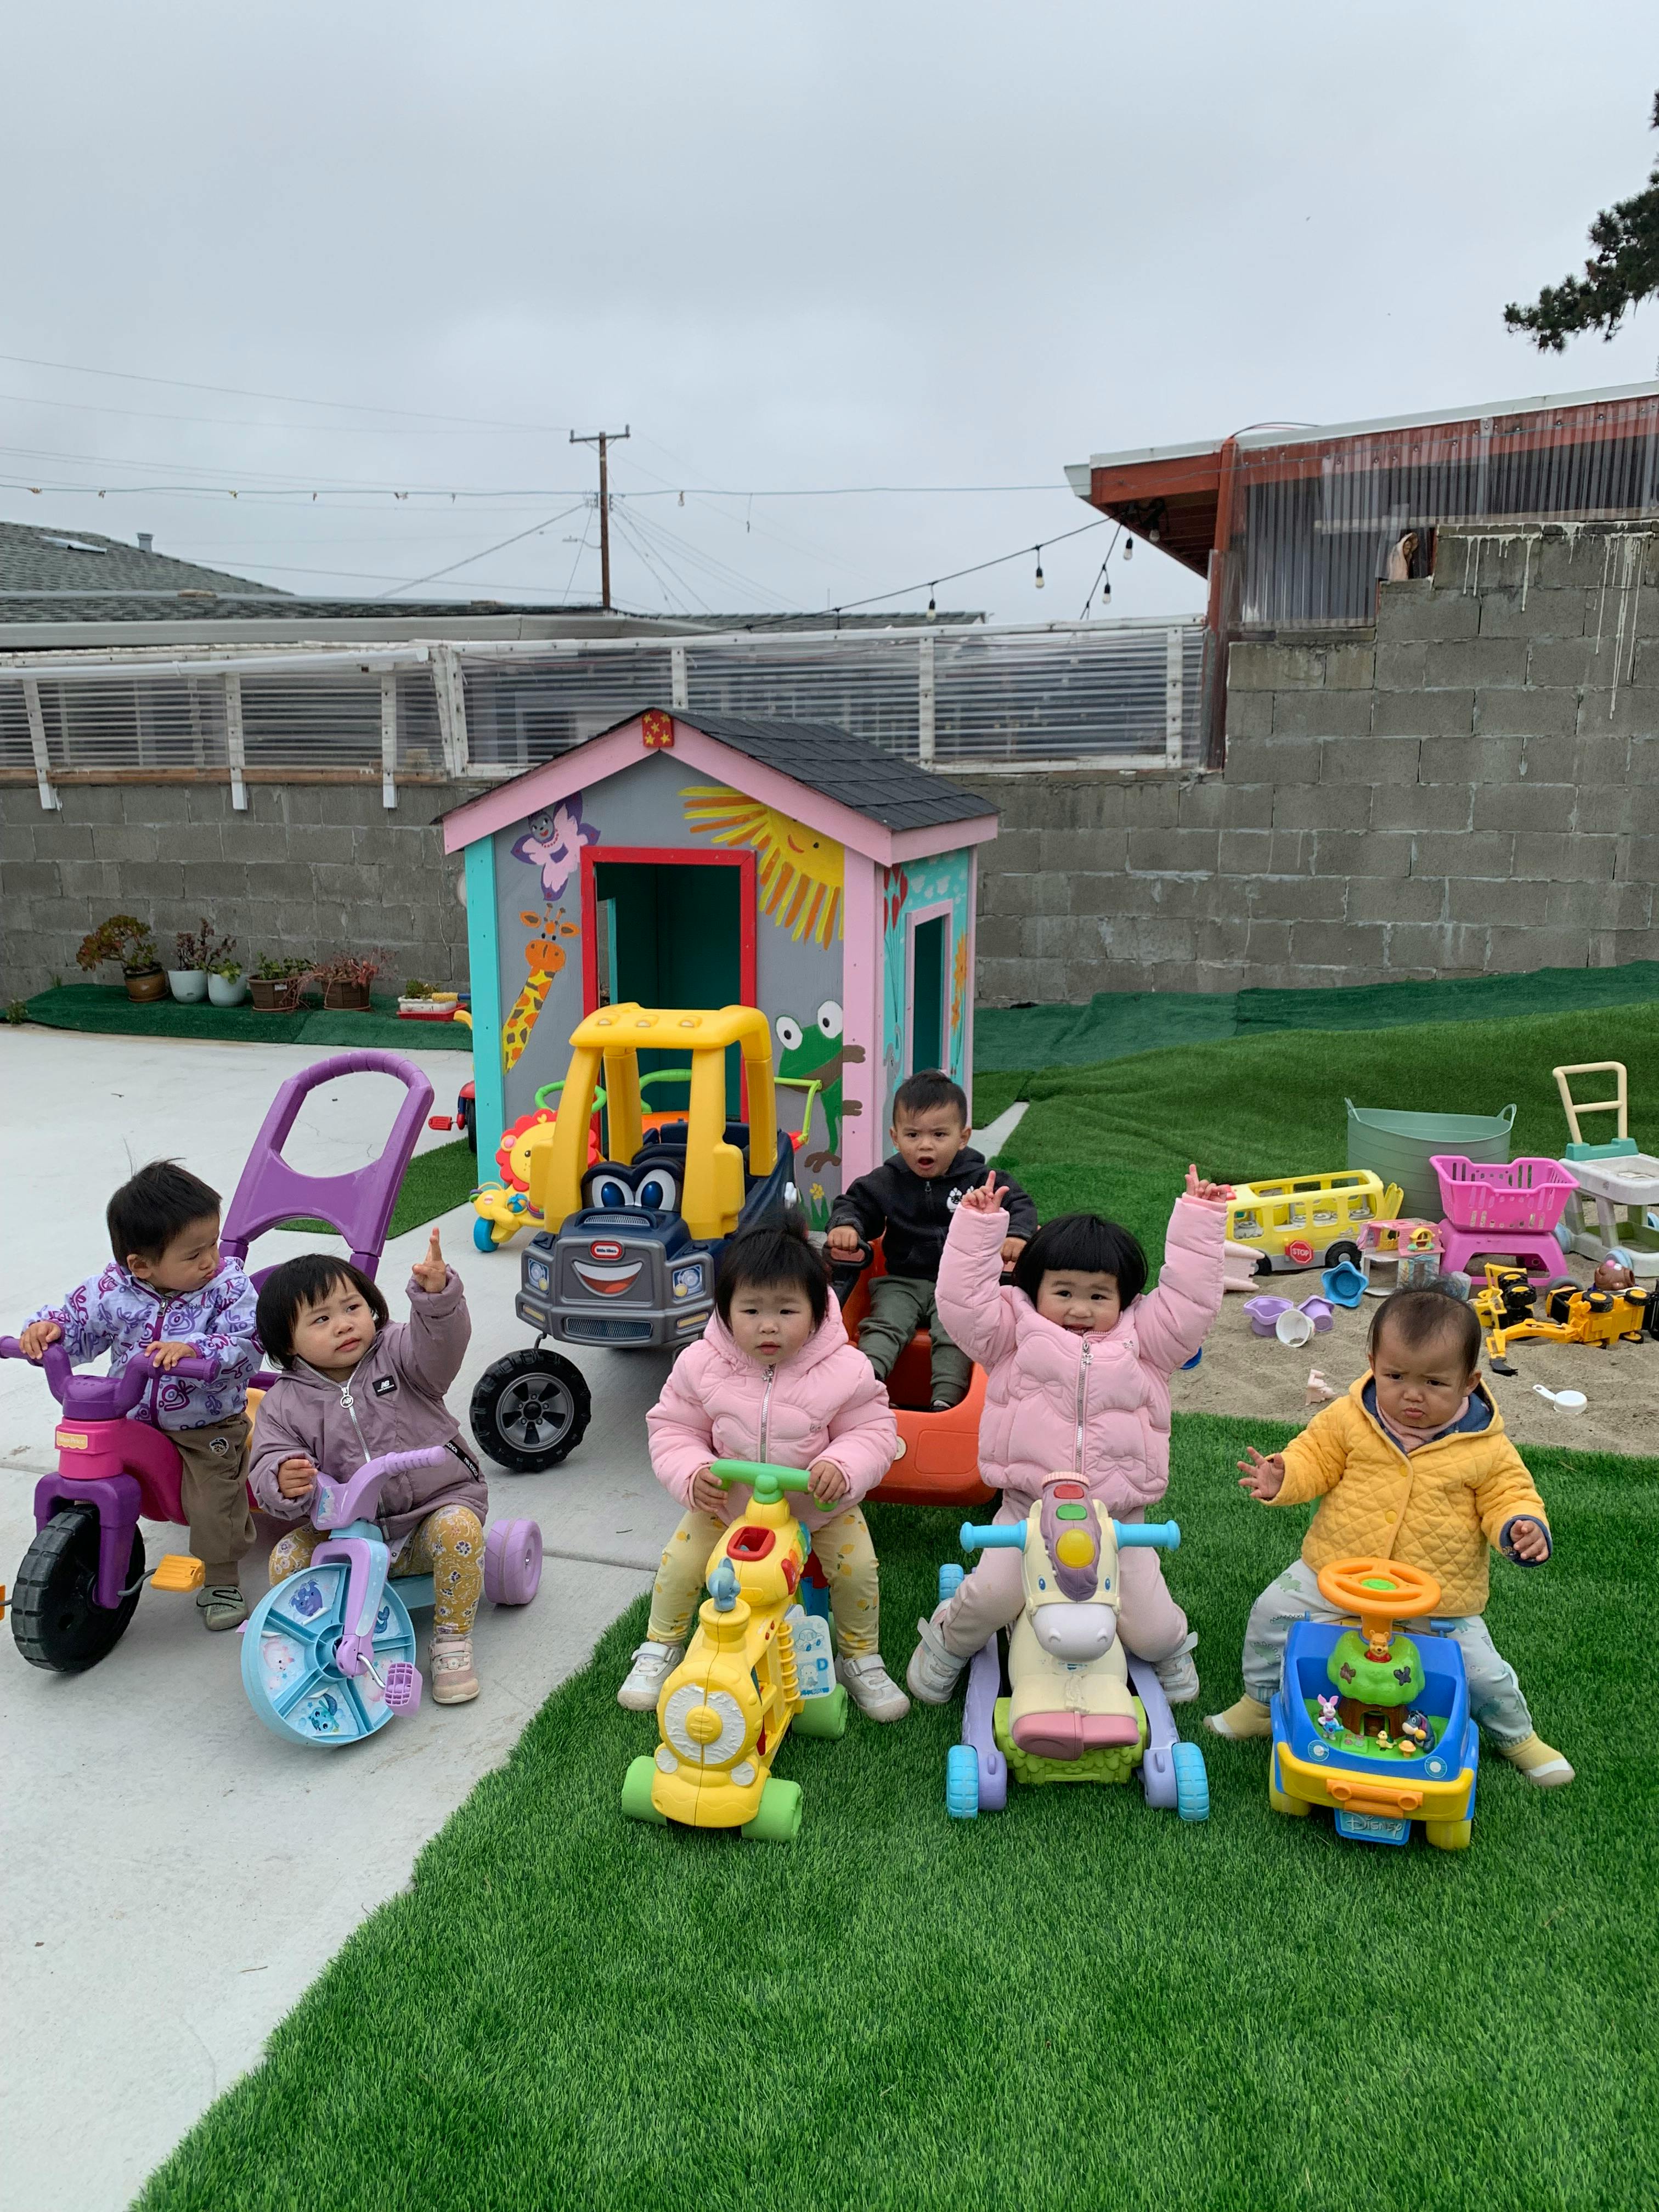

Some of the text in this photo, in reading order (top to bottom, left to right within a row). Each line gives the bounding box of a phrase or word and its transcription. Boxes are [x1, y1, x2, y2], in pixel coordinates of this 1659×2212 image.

[1293, 1248, 1309, 1256] STOP
[816, 1657, 828, 1671] D
[1342, 1811, 1403, 1838] Disney
